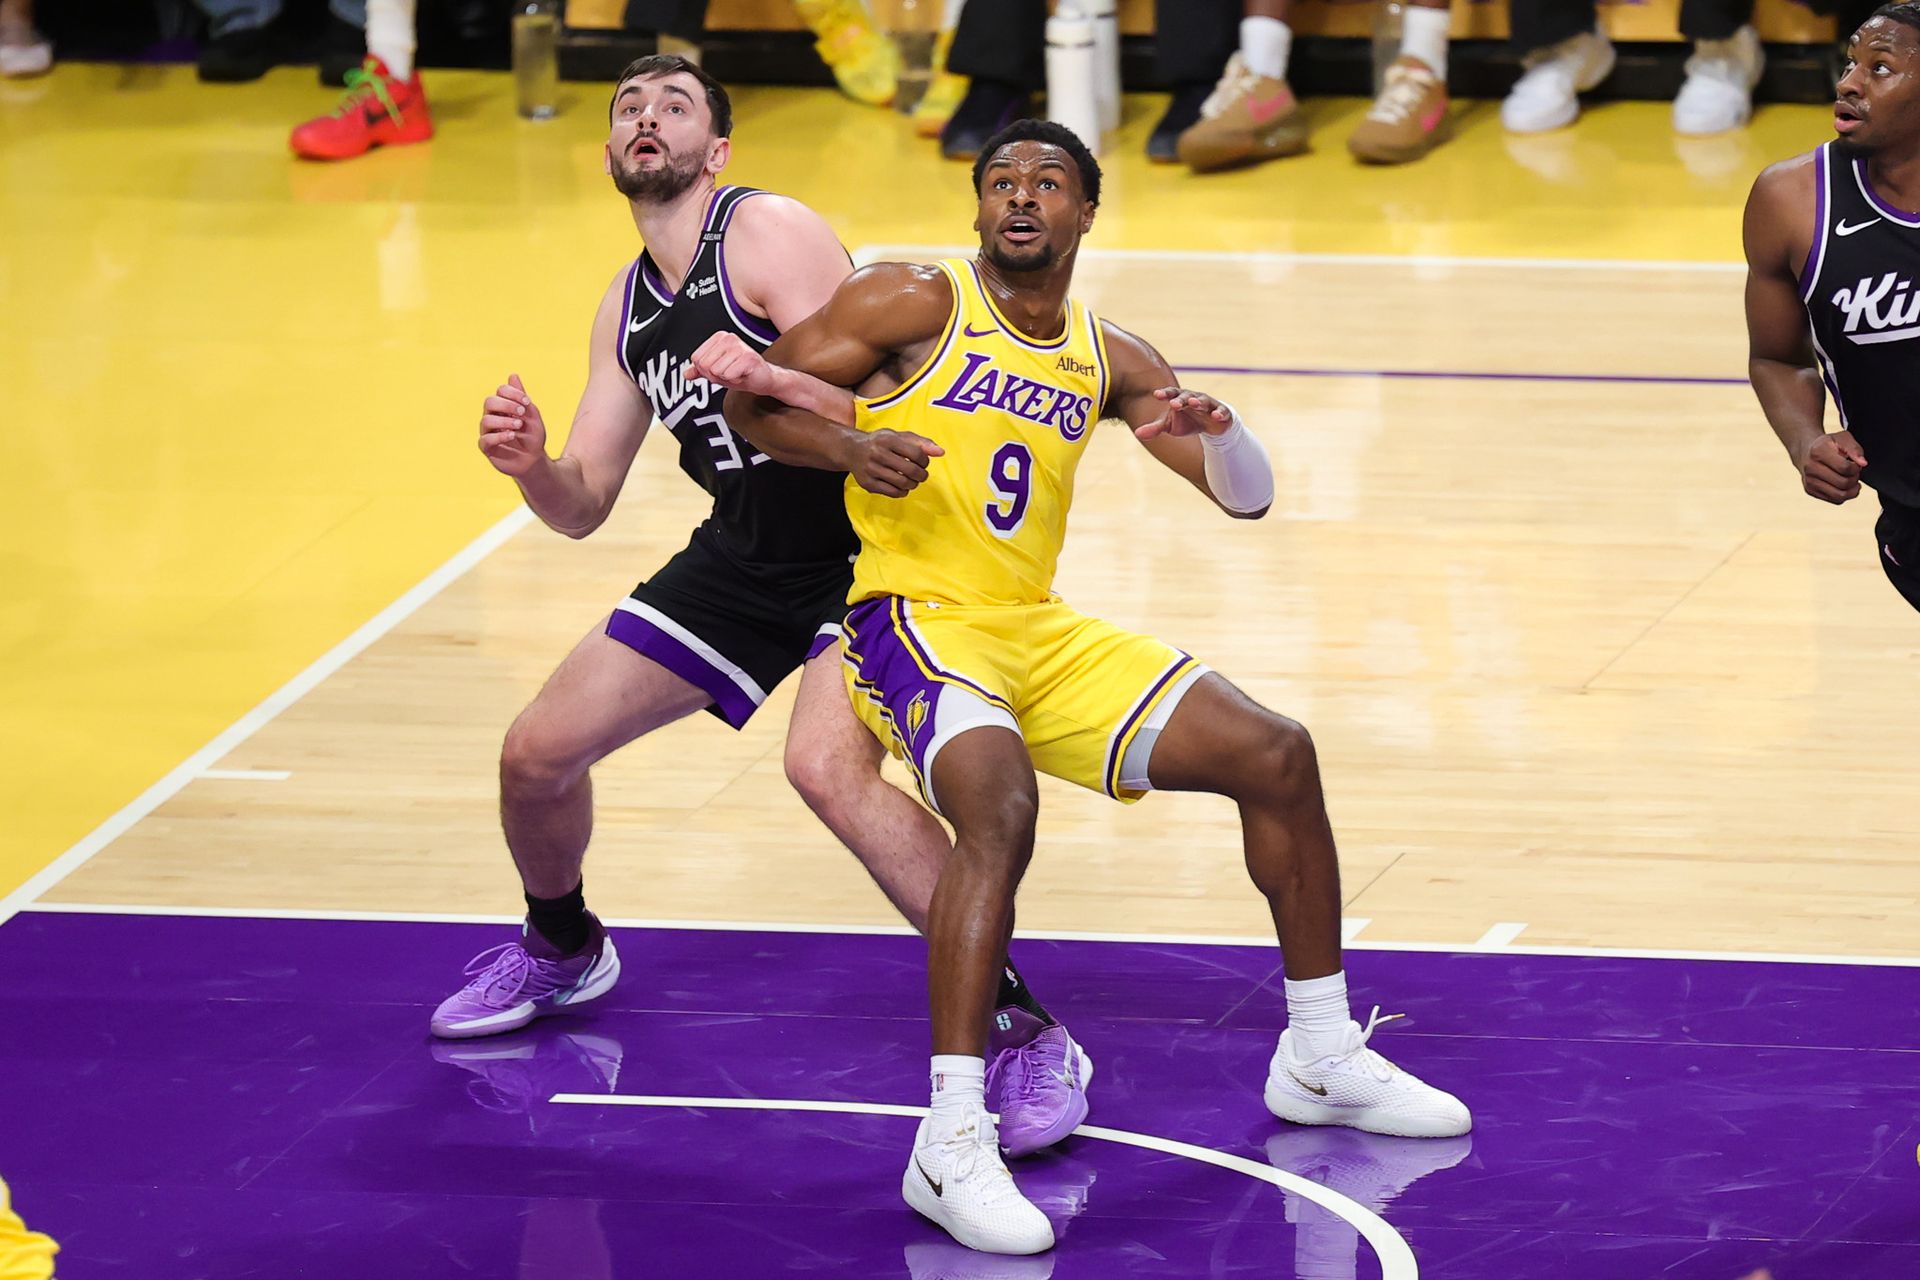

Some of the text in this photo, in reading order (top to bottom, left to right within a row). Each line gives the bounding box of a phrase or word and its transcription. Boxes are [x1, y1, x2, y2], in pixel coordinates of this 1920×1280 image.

[698, 275, 716, 288] Sutter
[698, 283, 718, 297] Health
[638, 349, 723, 430] King
[1056, 356, 1097, 377] Albert
[931, 352, 1093, 441] LAKERS
[693, 413, 772, 471] 3
[985, 441, 1033, 537] 9
